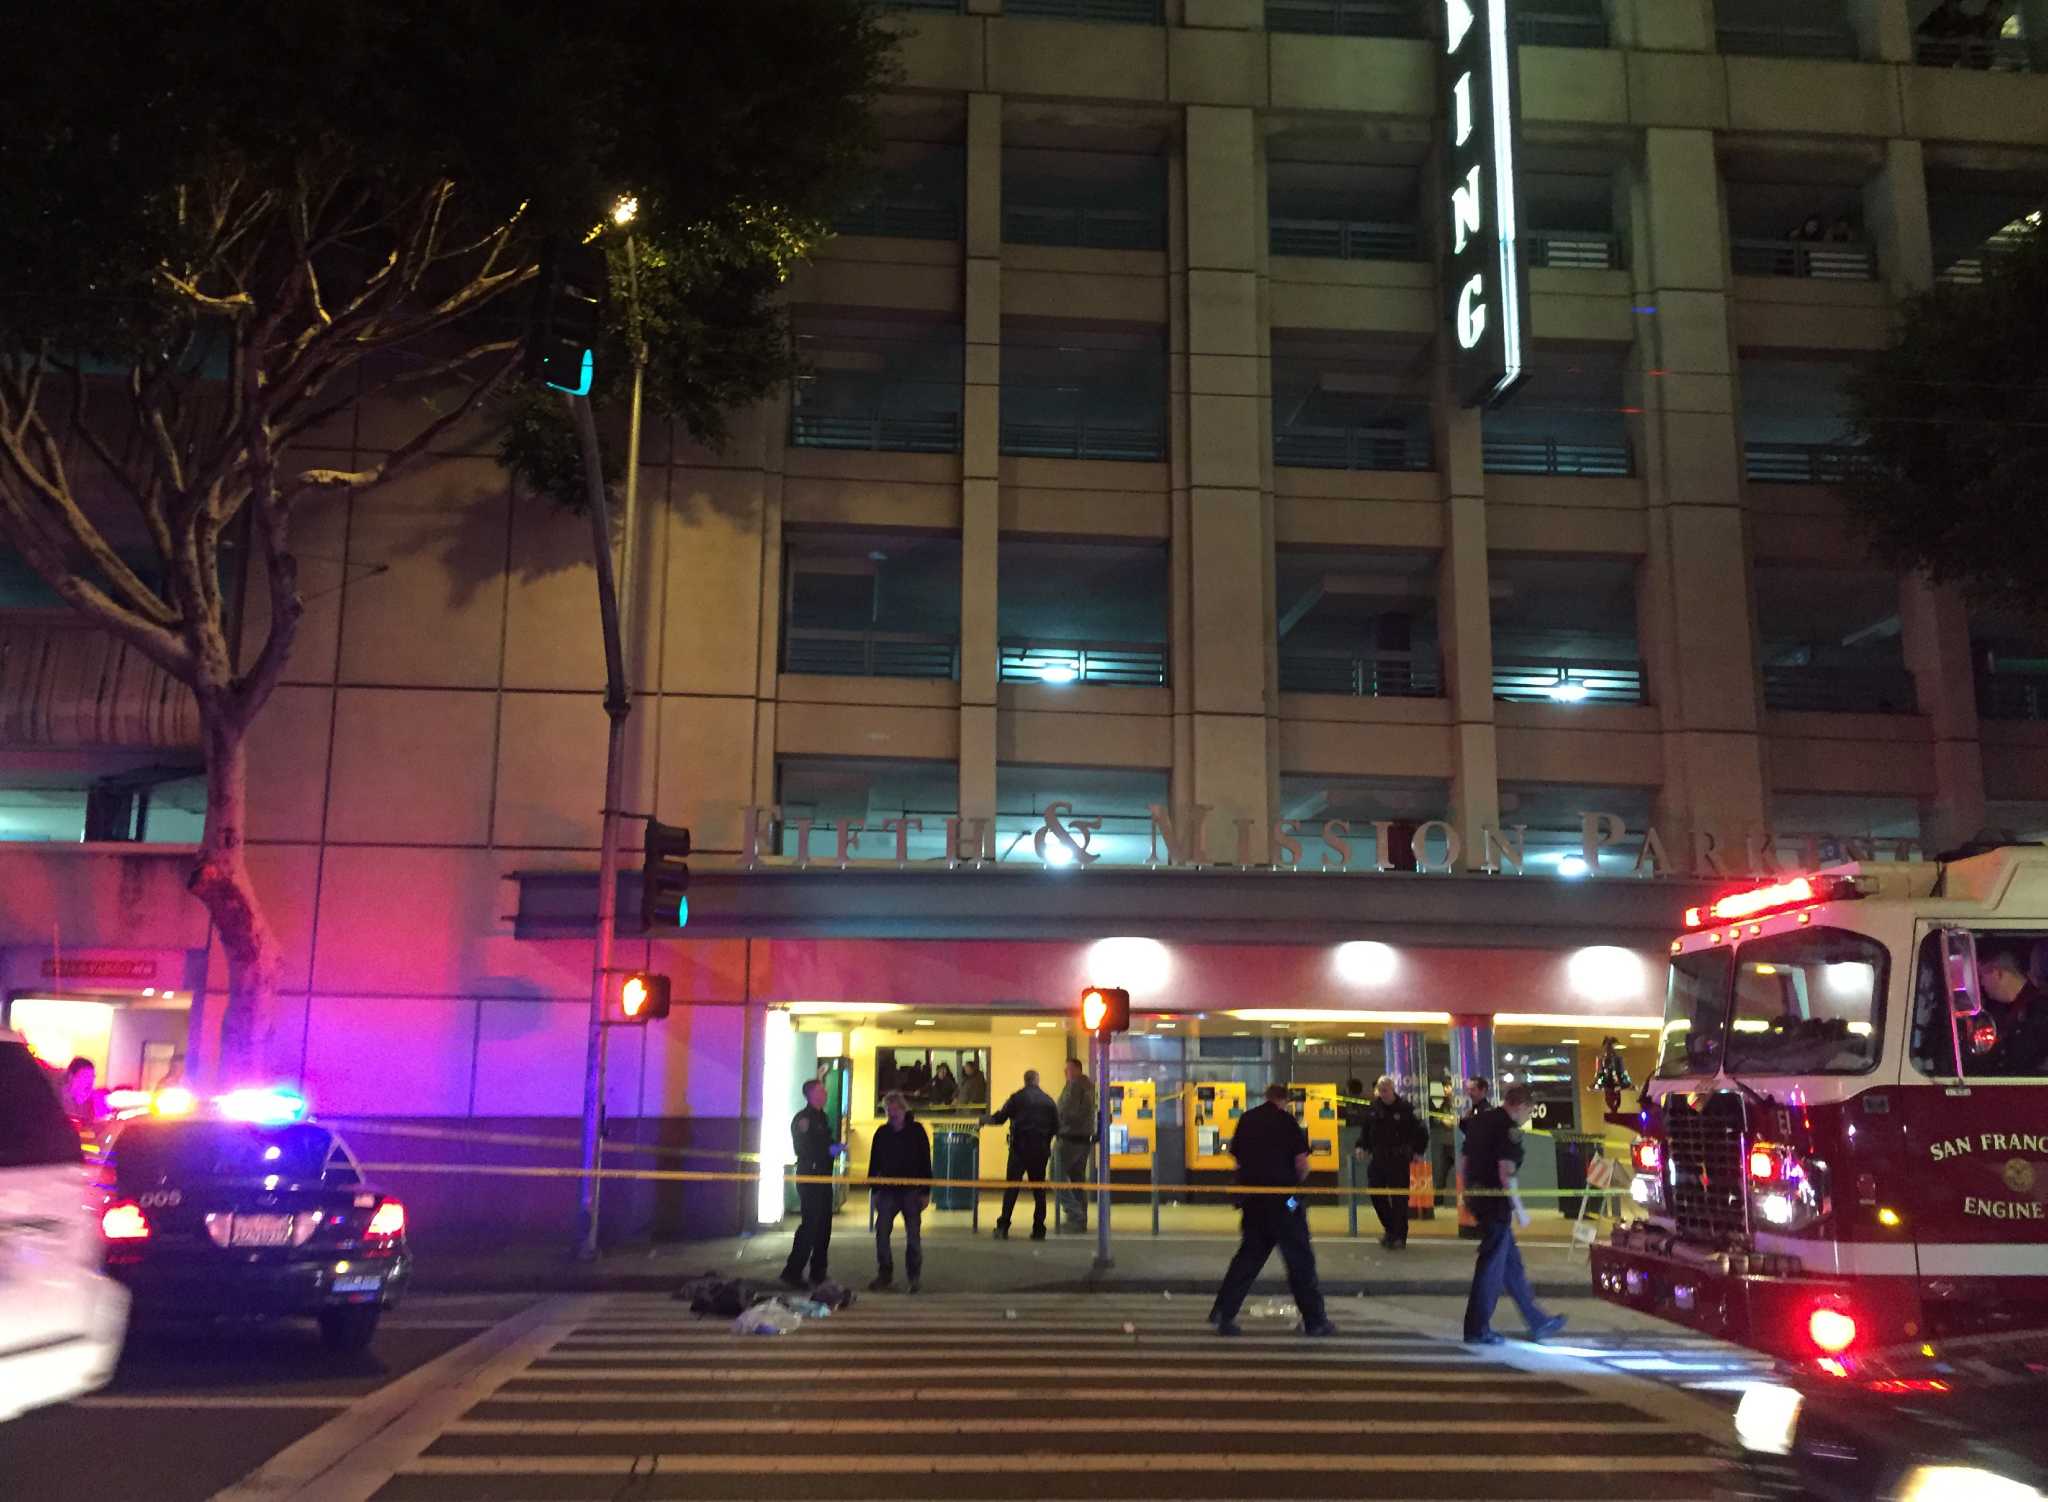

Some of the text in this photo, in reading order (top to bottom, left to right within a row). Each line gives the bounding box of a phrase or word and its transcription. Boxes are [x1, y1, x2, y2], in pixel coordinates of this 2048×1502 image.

[740, 807, 989, 863] FIFTH
[1034, 801, 1102, 864] &
[1144, 804, 1527, 871] MISSION
[1930, 1133, 2048, 1161] SAN FRANC
[1964, 1196, 2045, 1219] ENGINE
